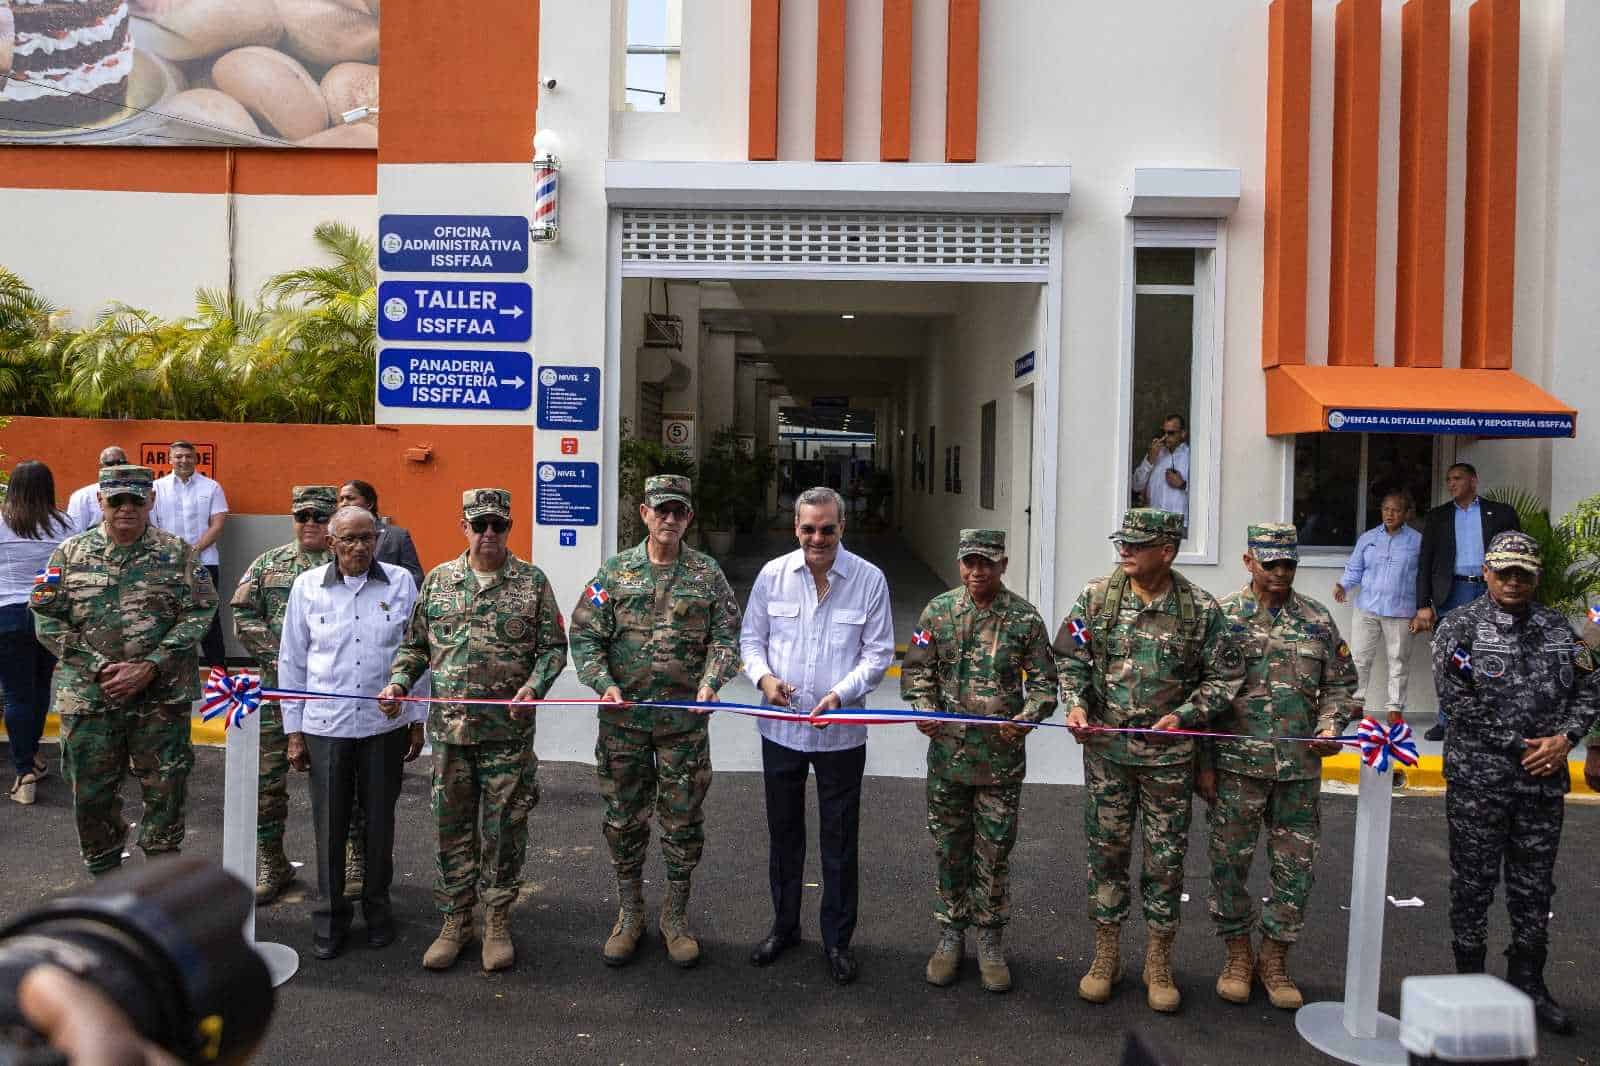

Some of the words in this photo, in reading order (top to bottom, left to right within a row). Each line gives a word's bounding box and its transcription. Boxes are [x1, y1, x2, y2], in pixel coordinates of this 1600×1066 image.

[434, 226, 491, 238] OFICINA
[403, 239, 522, 251] ADMINISTRATIVA
[431, 254, 493, 267] ISSFFAA
[414, 289, 497, 310] TALLER
[416, 318, 496, 334] ISSFFAA
[558, 374, 578, 382] NIVEL
[584, 374, 590, 382] 2
[412, 387, 491, 404] ISSFFAA
[1344, 416, 1378, 424] VENTAS
[1380, 416, 1390, 425] AL
[1391, 417, 1425, 425] DETALLE
[1426, 416, 1476, 427] PANADERÍA
[1477, 418, 1484, 426] Y
[1485, 418, 1536, 428] REPOSTERÍA
[1537, 420, 1572, 429] ISSFFAA
[673, 426, 681, 436] 5
[580, 469, 585, 478] 1
[565, 536, 570, 544] 1
